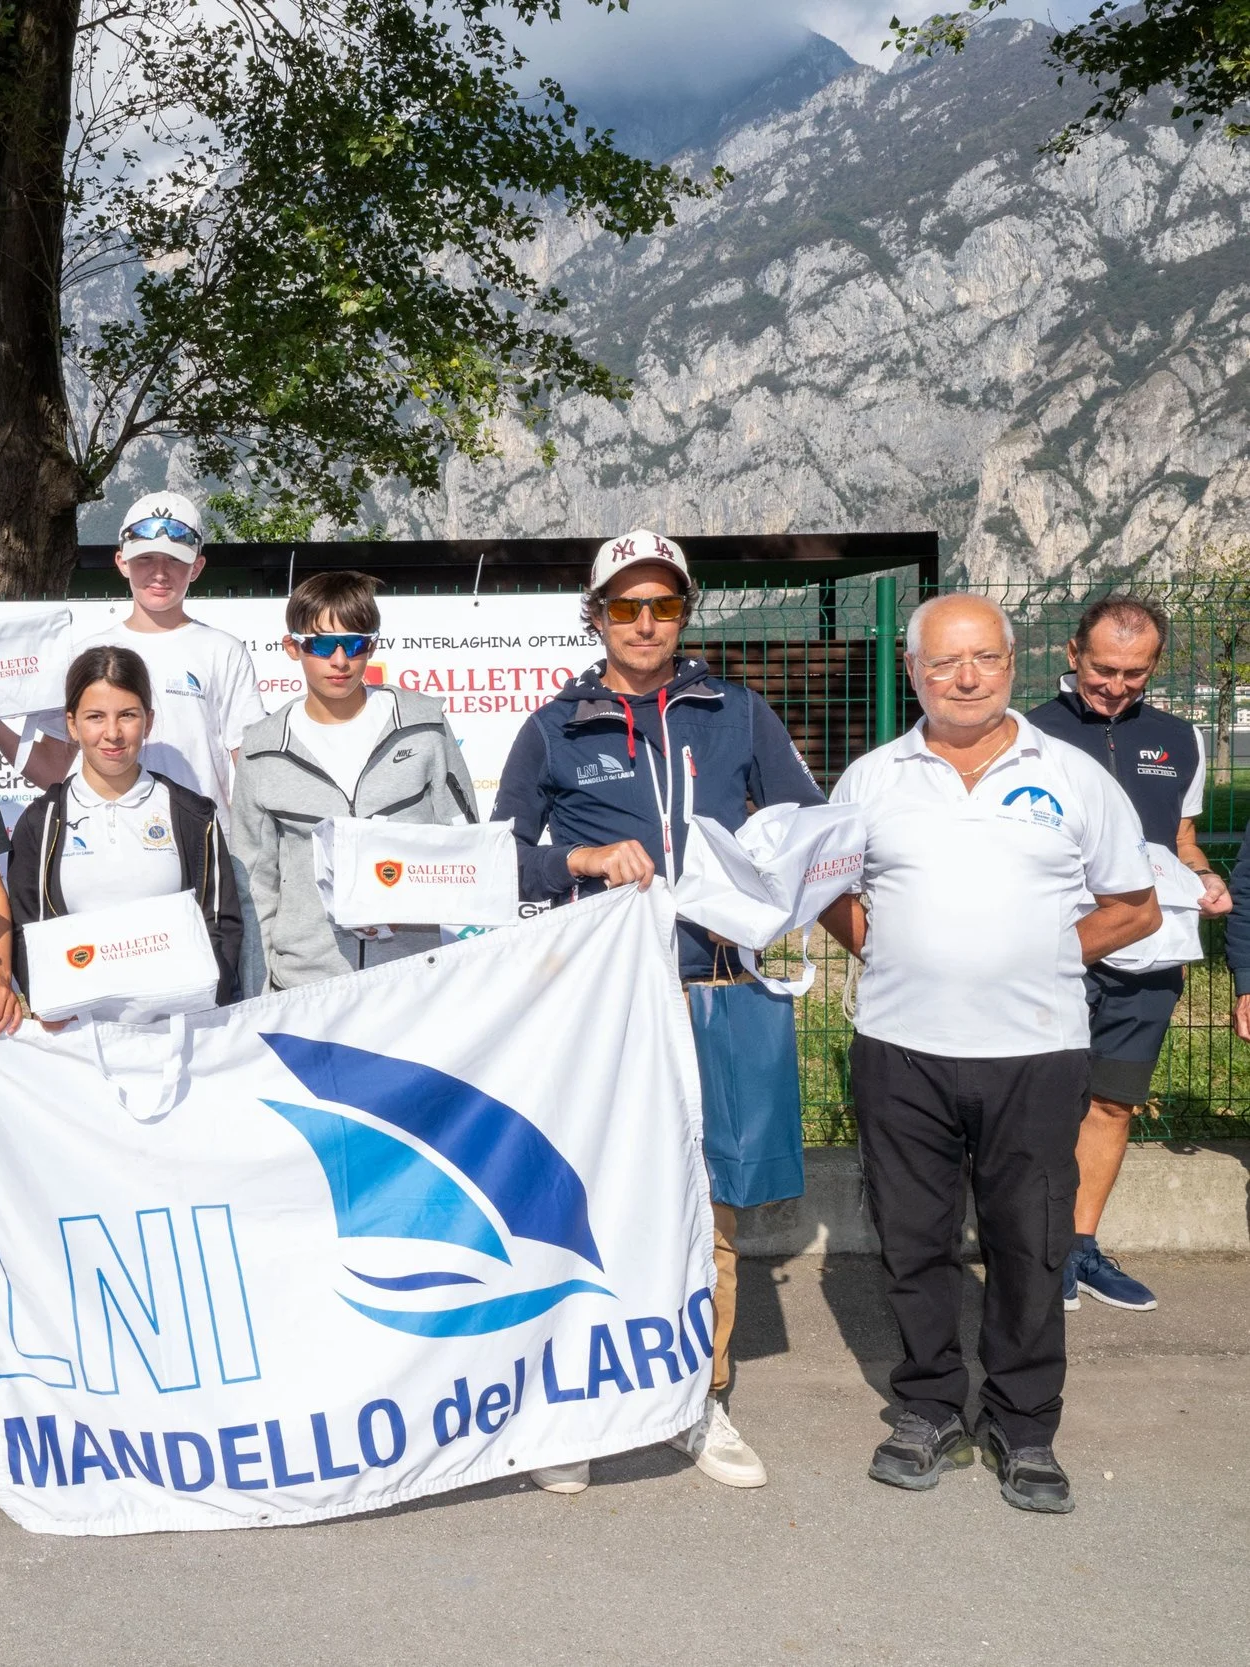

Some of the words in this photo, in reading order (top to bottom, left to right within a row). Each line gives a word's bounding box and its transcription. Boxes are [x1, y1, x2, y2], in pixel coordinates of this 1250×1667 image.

[612, 538, 636, 562] NY
[653, 535, 675, 561] LA
[402, 636, 522, 650] INTERLAGHINA
[528, 634, 600, 648] OPTIMIS
[398, 667, 575, 693] GALLETTO
[396, 748, 413, 757] NIKE
[1139, 750, 1161, 760] FIV
[576, 763, 599, 779] LNI
[578, 774, 609, 786] MANDELLO
[407, 864, 477, 875] GALLETTO
[804, 853, 863, 878] GALLETTO
[408, 875, 477, 884] VALLESPLUGA
[100, 932, 169, 954] GALLETTO
[101, 942, 171, 961] VALLESPLUGA
[3, 1397, 407, 1492] MANDELLO
[433, 1368, 527, 1447] del
[541, 1286, 715, 1405] LARIO
